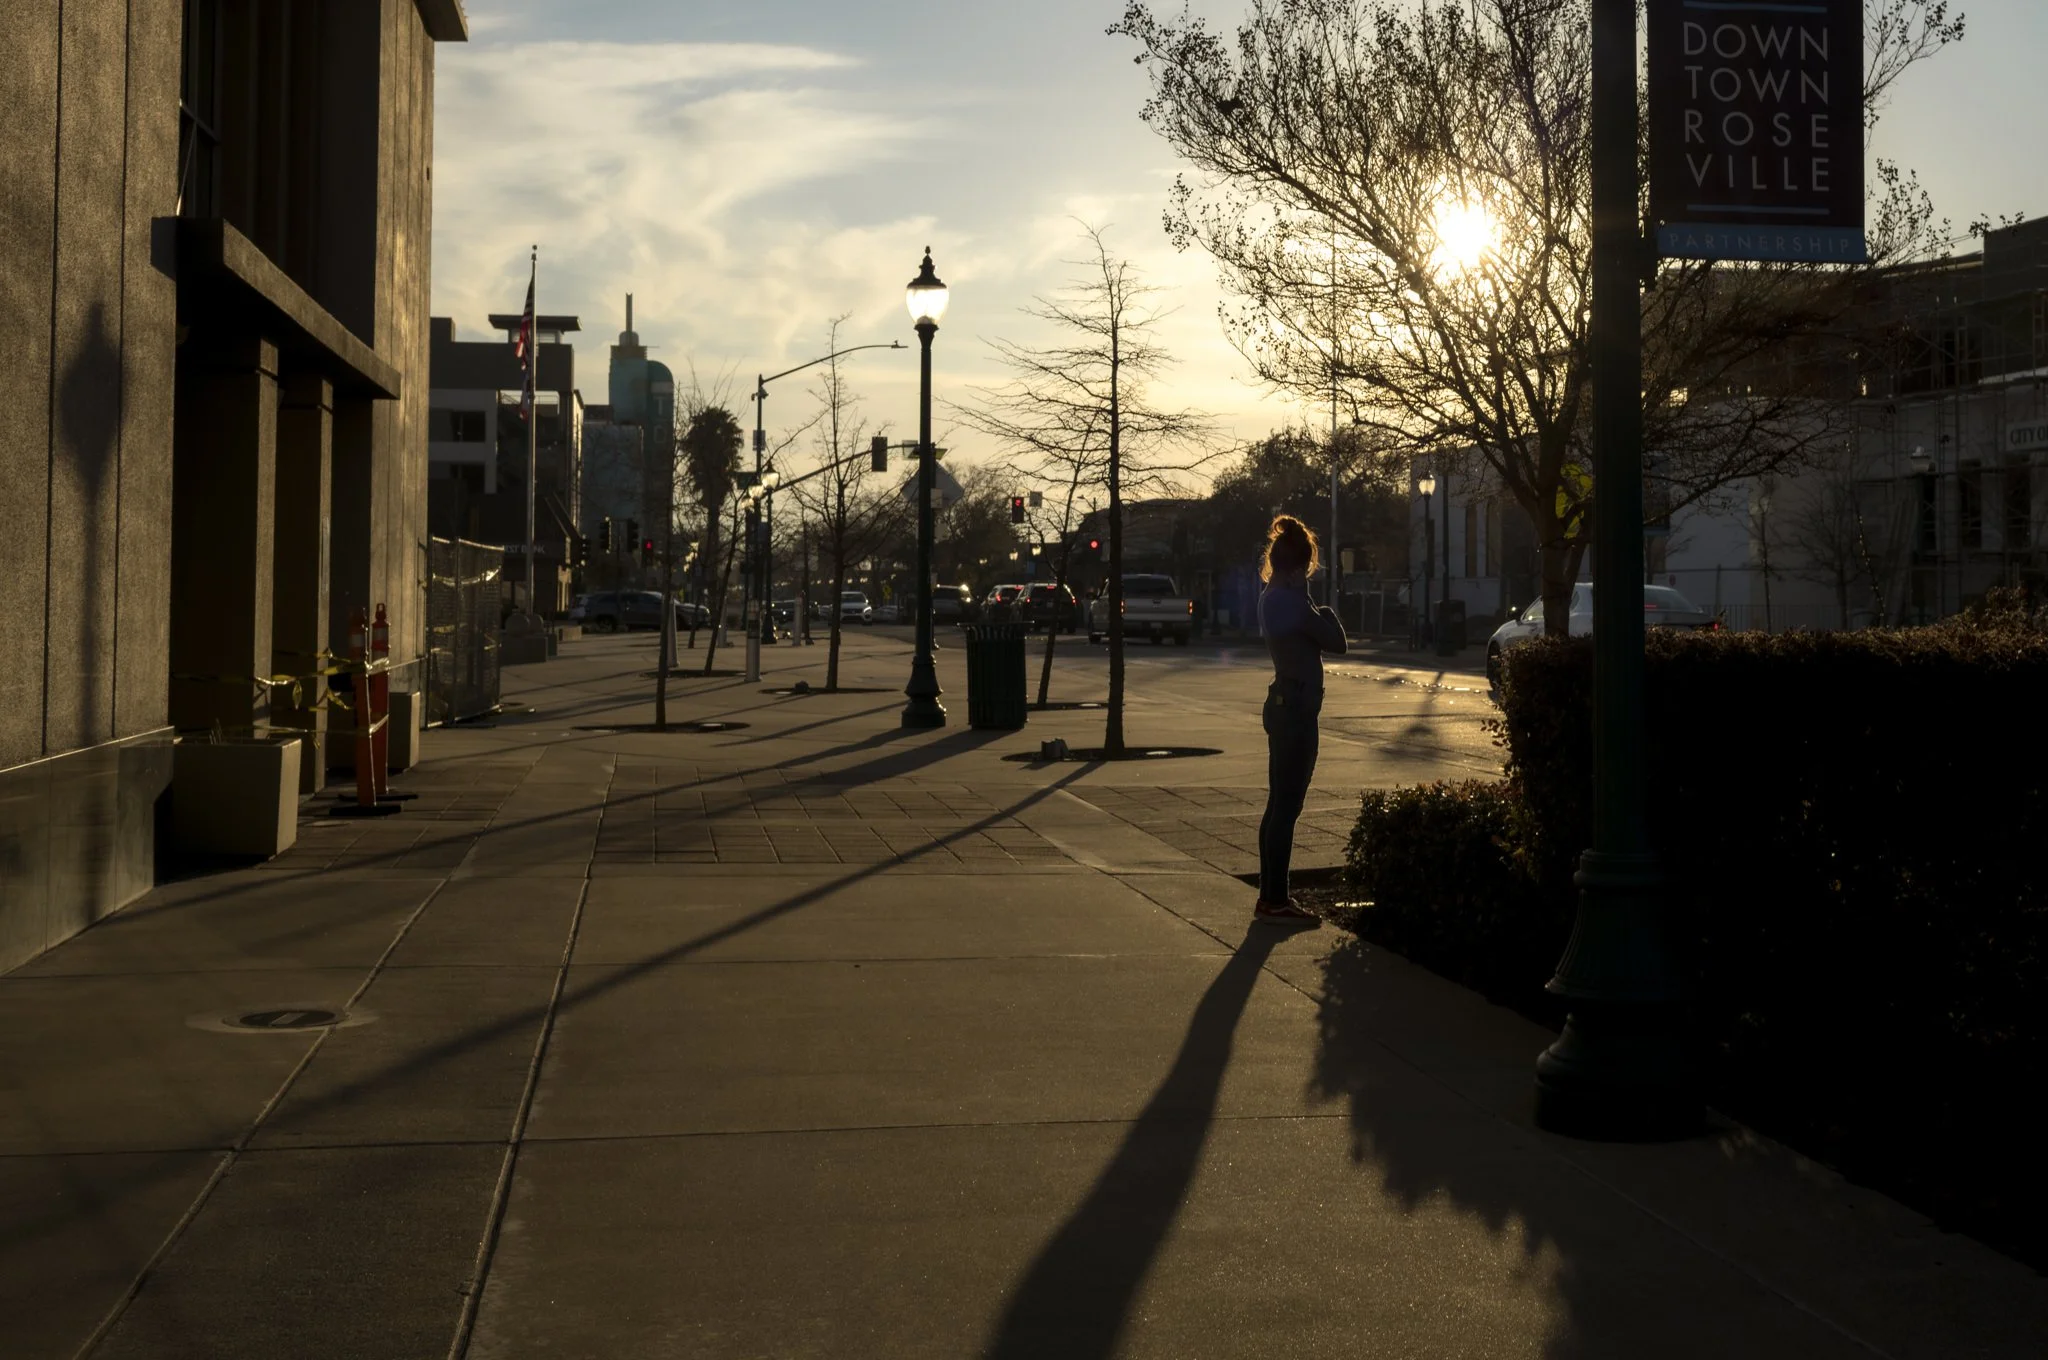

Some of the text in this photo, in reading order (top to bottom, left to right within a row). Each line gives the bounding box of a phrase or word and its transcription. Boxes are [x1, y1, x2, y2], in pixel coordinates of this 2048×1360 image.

[1683, 21, 1829, 62] DOWN
[1684, 65, 1829, 105] TOWN
[1684, 109, 1829, 149] ROSE
[1685, 153, 1830, 192] VILLE
[1669, 233, 1850, 254] PARTNERSHIP
[2010, 425, 2048, 445] CITY O
